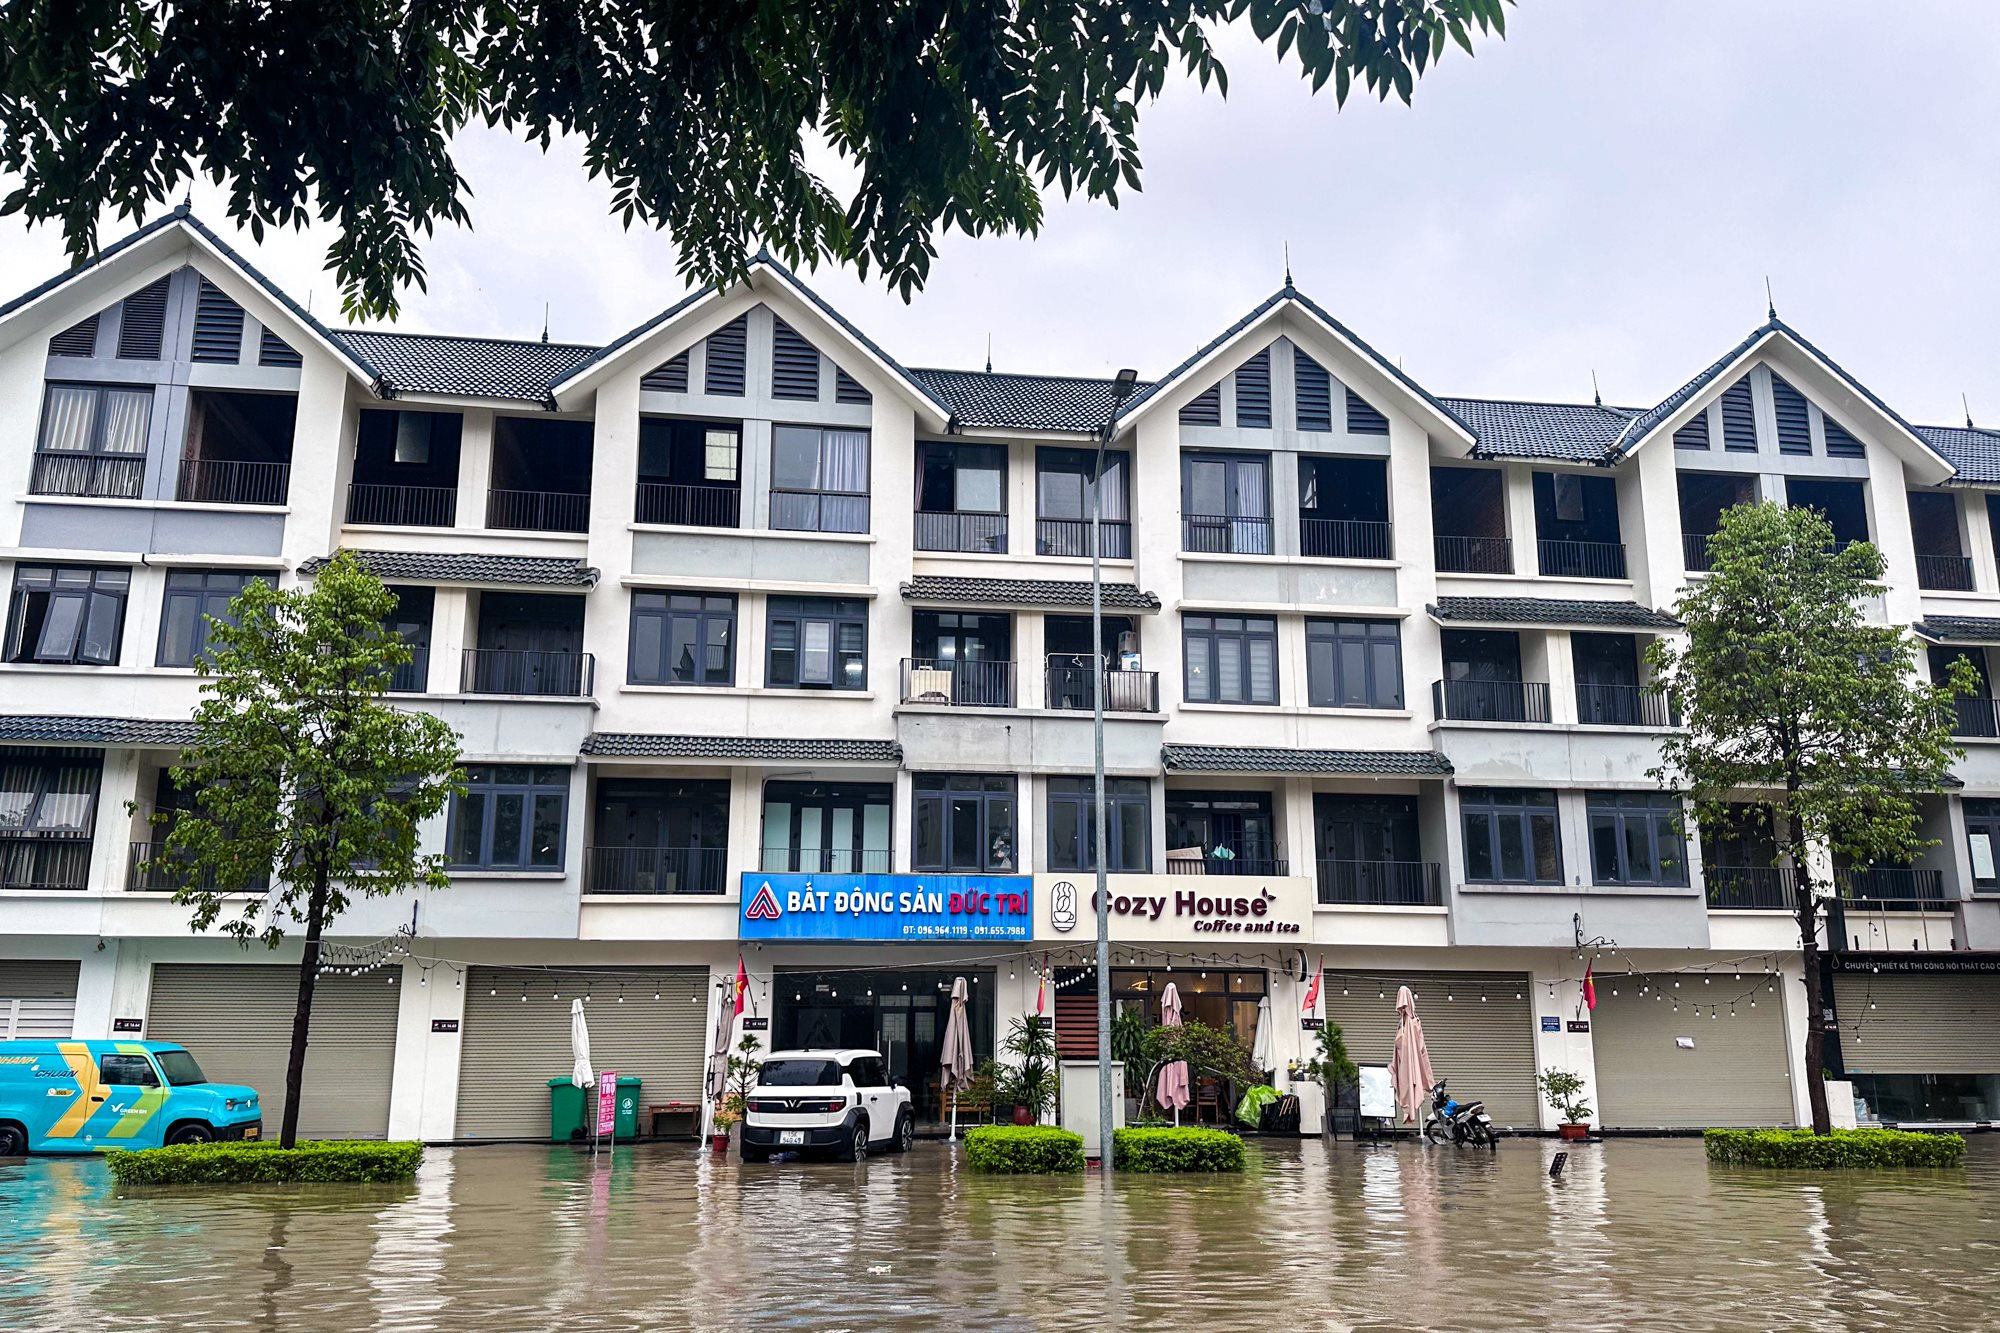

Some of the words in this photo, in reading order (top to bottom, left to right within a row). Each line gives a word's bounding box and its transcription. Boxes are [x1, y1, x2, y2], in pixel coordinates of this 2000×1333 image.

[787, 881, 830, 913] BẤT
[834, 887, 893, 917] ĐỘNG
[899, 884, 943, 914] SẢN
[948, 888, 991, 914] ĐỨC
[994, 889, 1029, 916] TRÍ
[1175, 890, 1268, 917] House
[902, 925, 916, 935] ĐT:
[917, 925, 968, 935] 096.964.1119
[974, 926, 1026, 936] 091.655.7988
[1193, 920, 1242, 933] Coffee
[1245, 920, 1274, 933] and
[1277, 921, 1300, 934] tea
[1980, 962, 1995, 970] CAO
